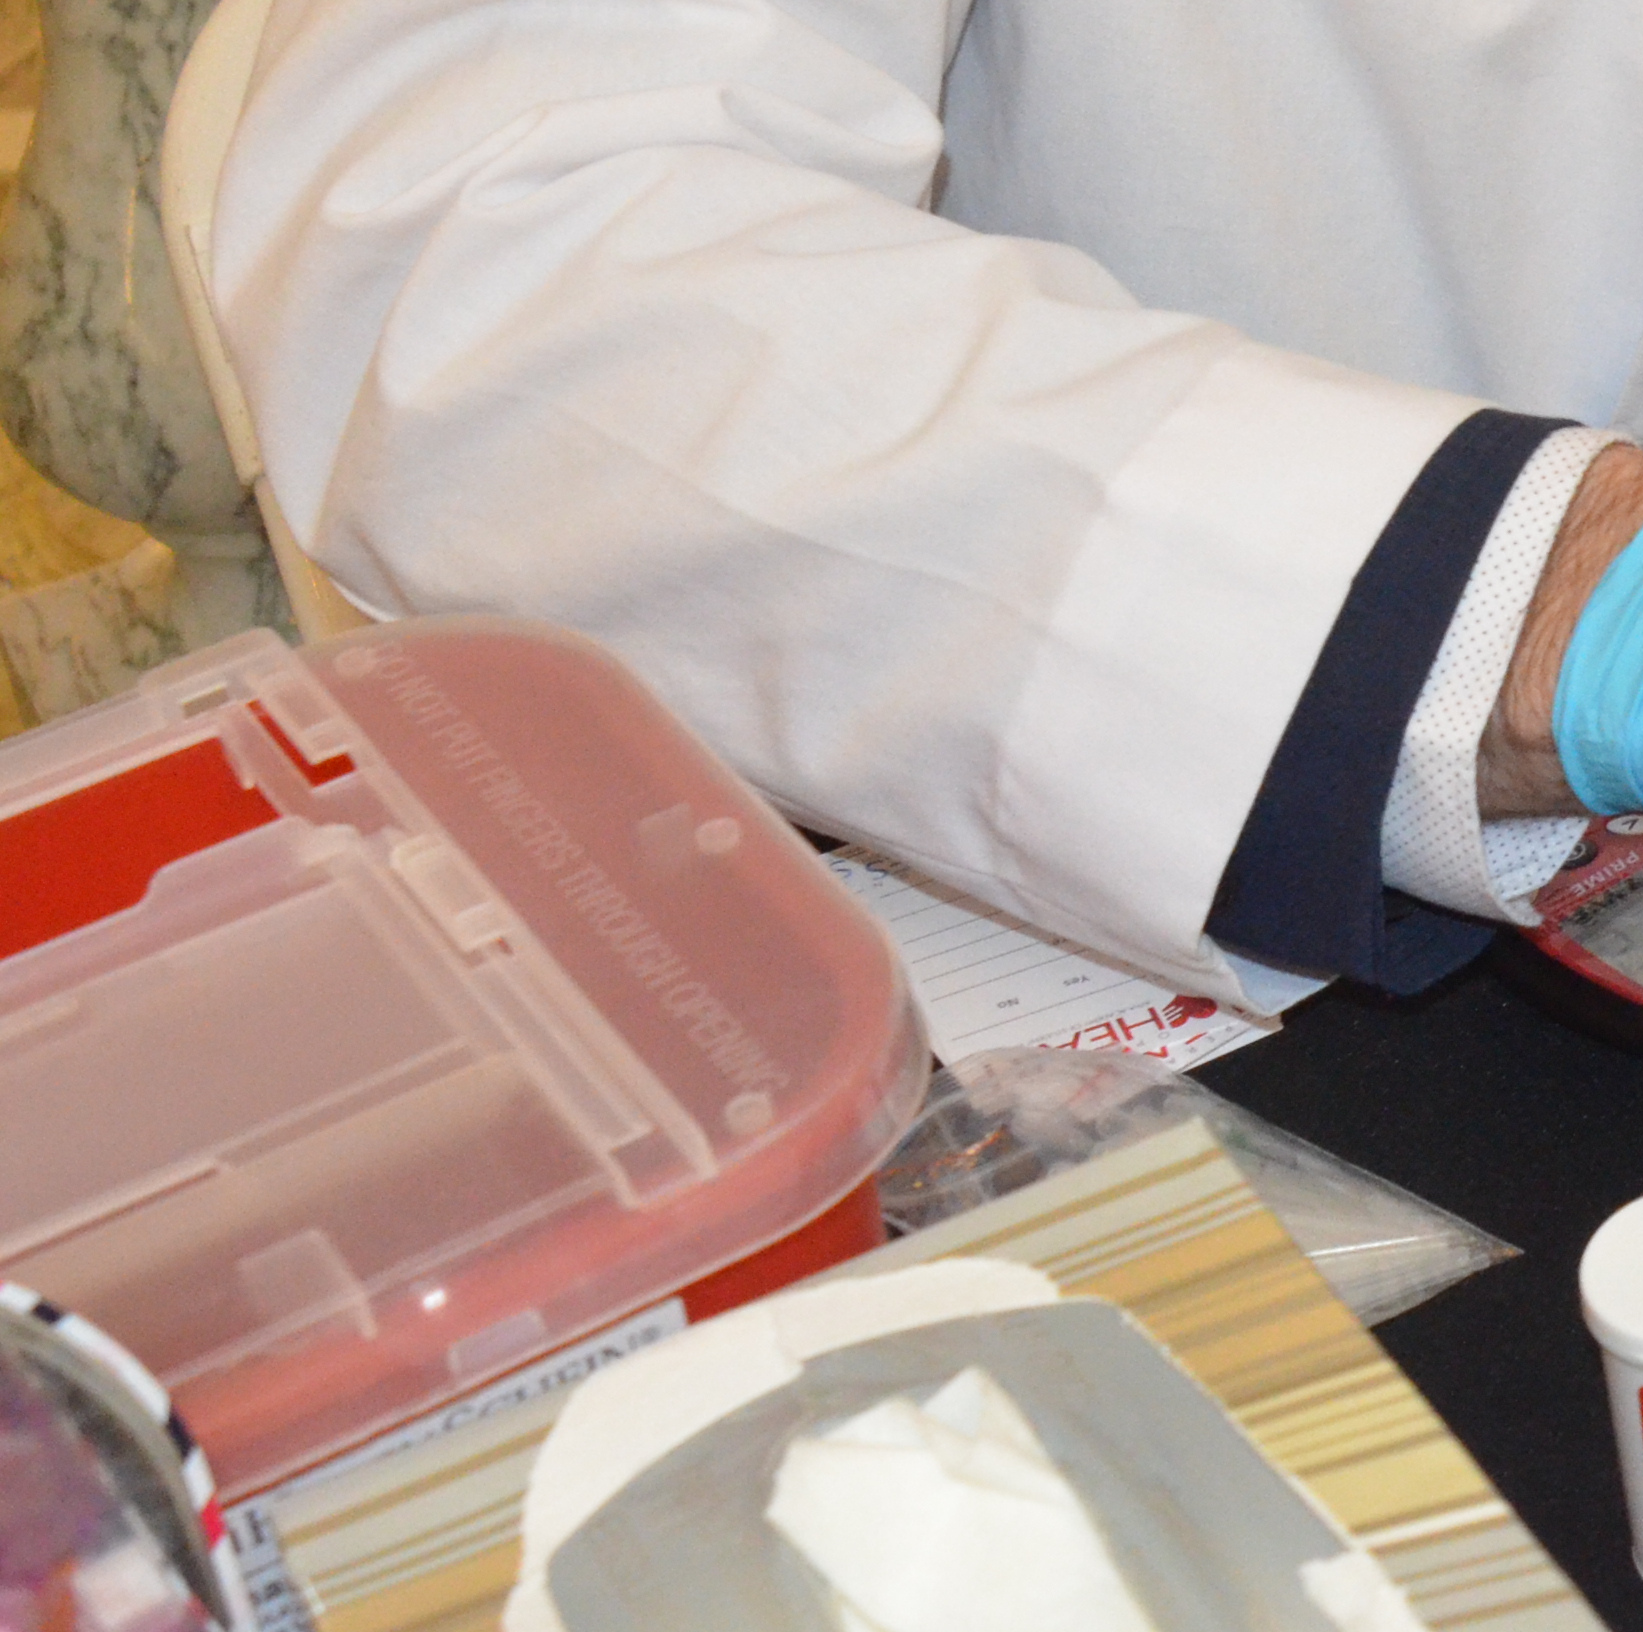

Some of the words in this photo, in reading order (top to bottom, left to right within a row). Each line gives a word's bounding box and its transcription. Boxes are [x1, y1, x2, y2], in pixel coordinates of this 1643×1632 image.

[390, 674, 462, 728] NOT
[432, 719, 499, 765] PUT
[467, 757, 585, 871] FINGERS
[556, 861, 691, 990] THROUGH
[1570, 851, 1640, 897] PRIME
[996, 997, 1020, 1009] No
[1063, 975, 1090, 988] Yes
[1038, 1006, 1166, 1052] HEA
